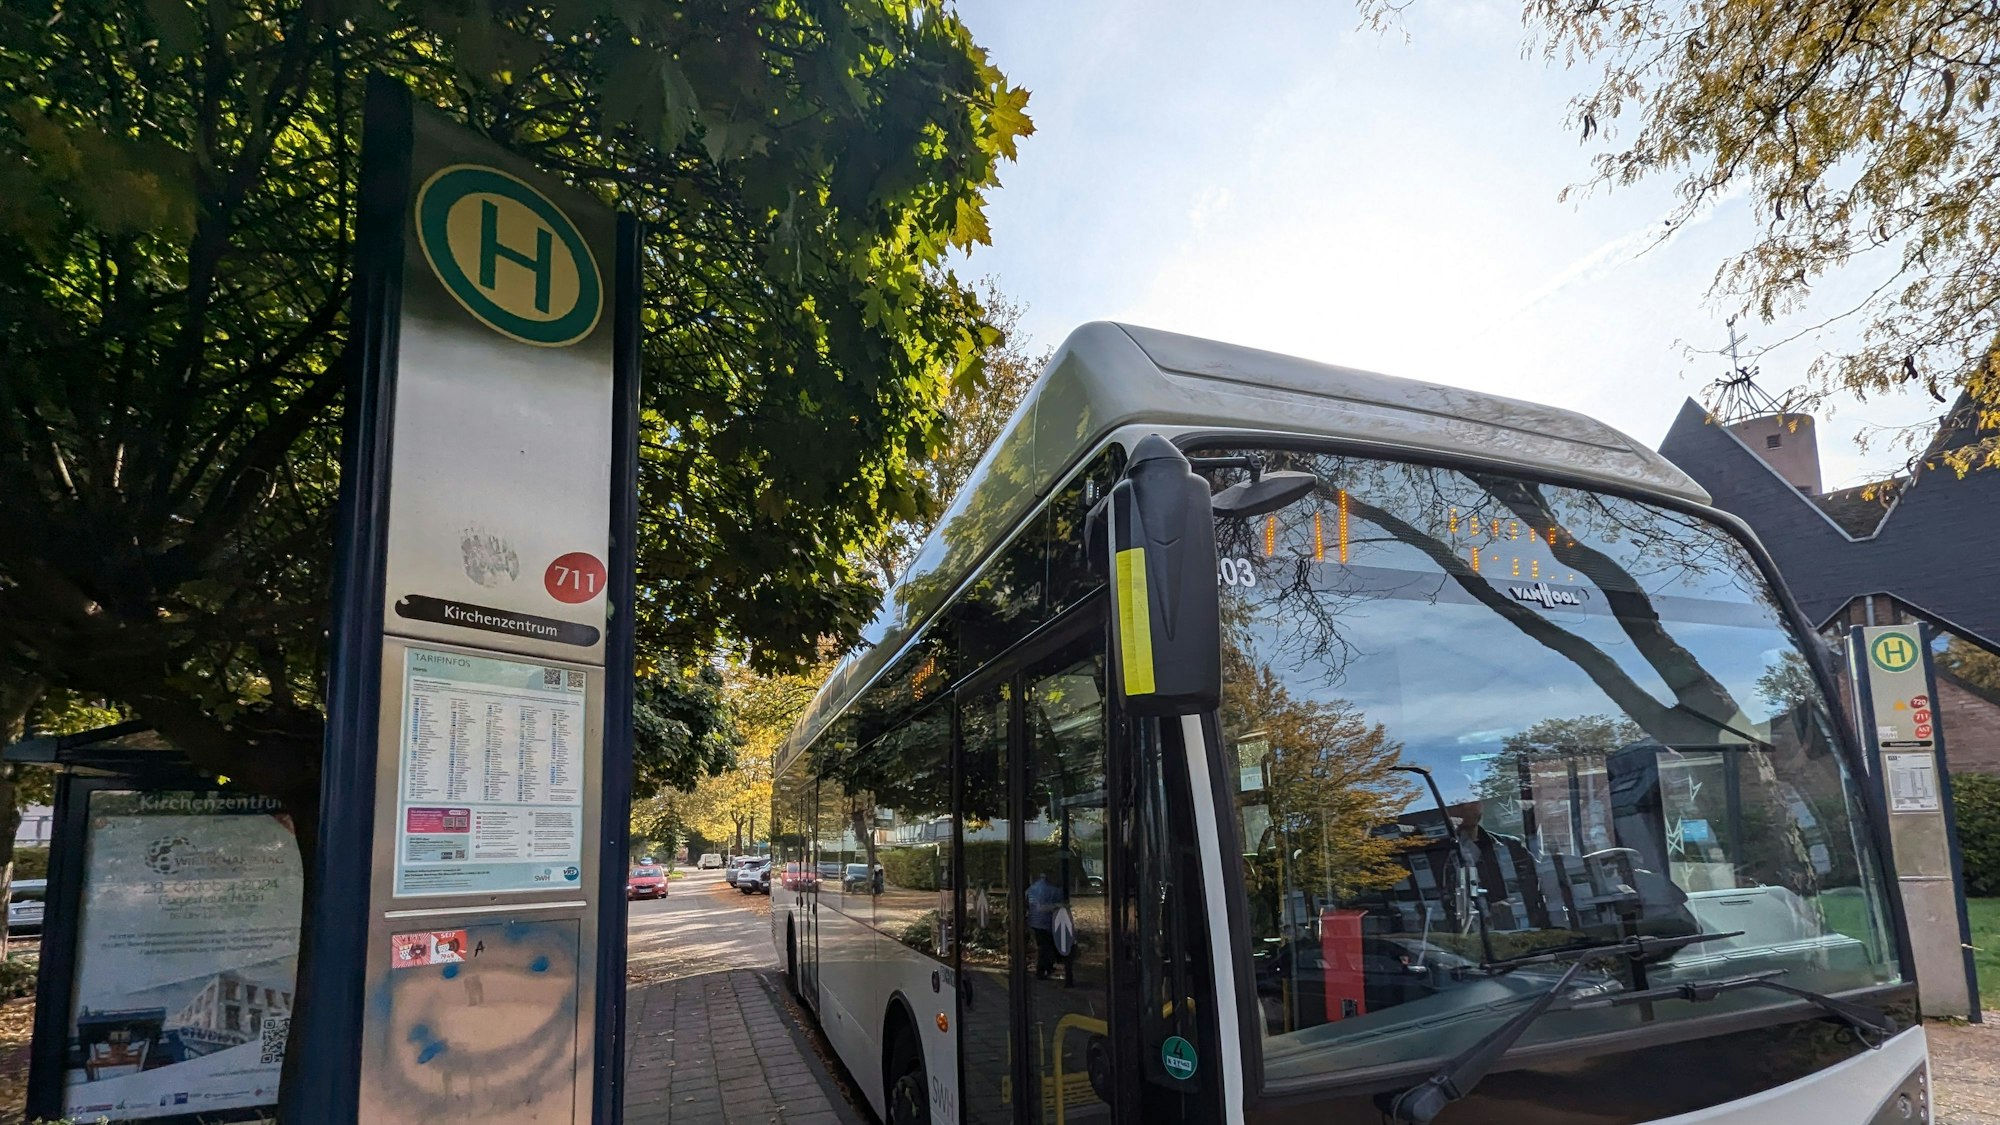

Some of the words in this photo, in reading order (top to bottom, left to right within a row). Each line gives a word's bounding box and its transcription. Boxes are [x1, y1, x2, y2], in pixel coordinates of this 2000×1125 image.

[479, 199, 552, 315] H
[554, 566, 595, 593] 711
[444, 604, 558, 637] Kirchenzentrum
[415, 653, 471, 668] TARIFINFOS
[1883, 640, 1906, 664] H
[1173, 1040, 1184, 1058] 4
[932, 1075, 954, 1123] SWH
